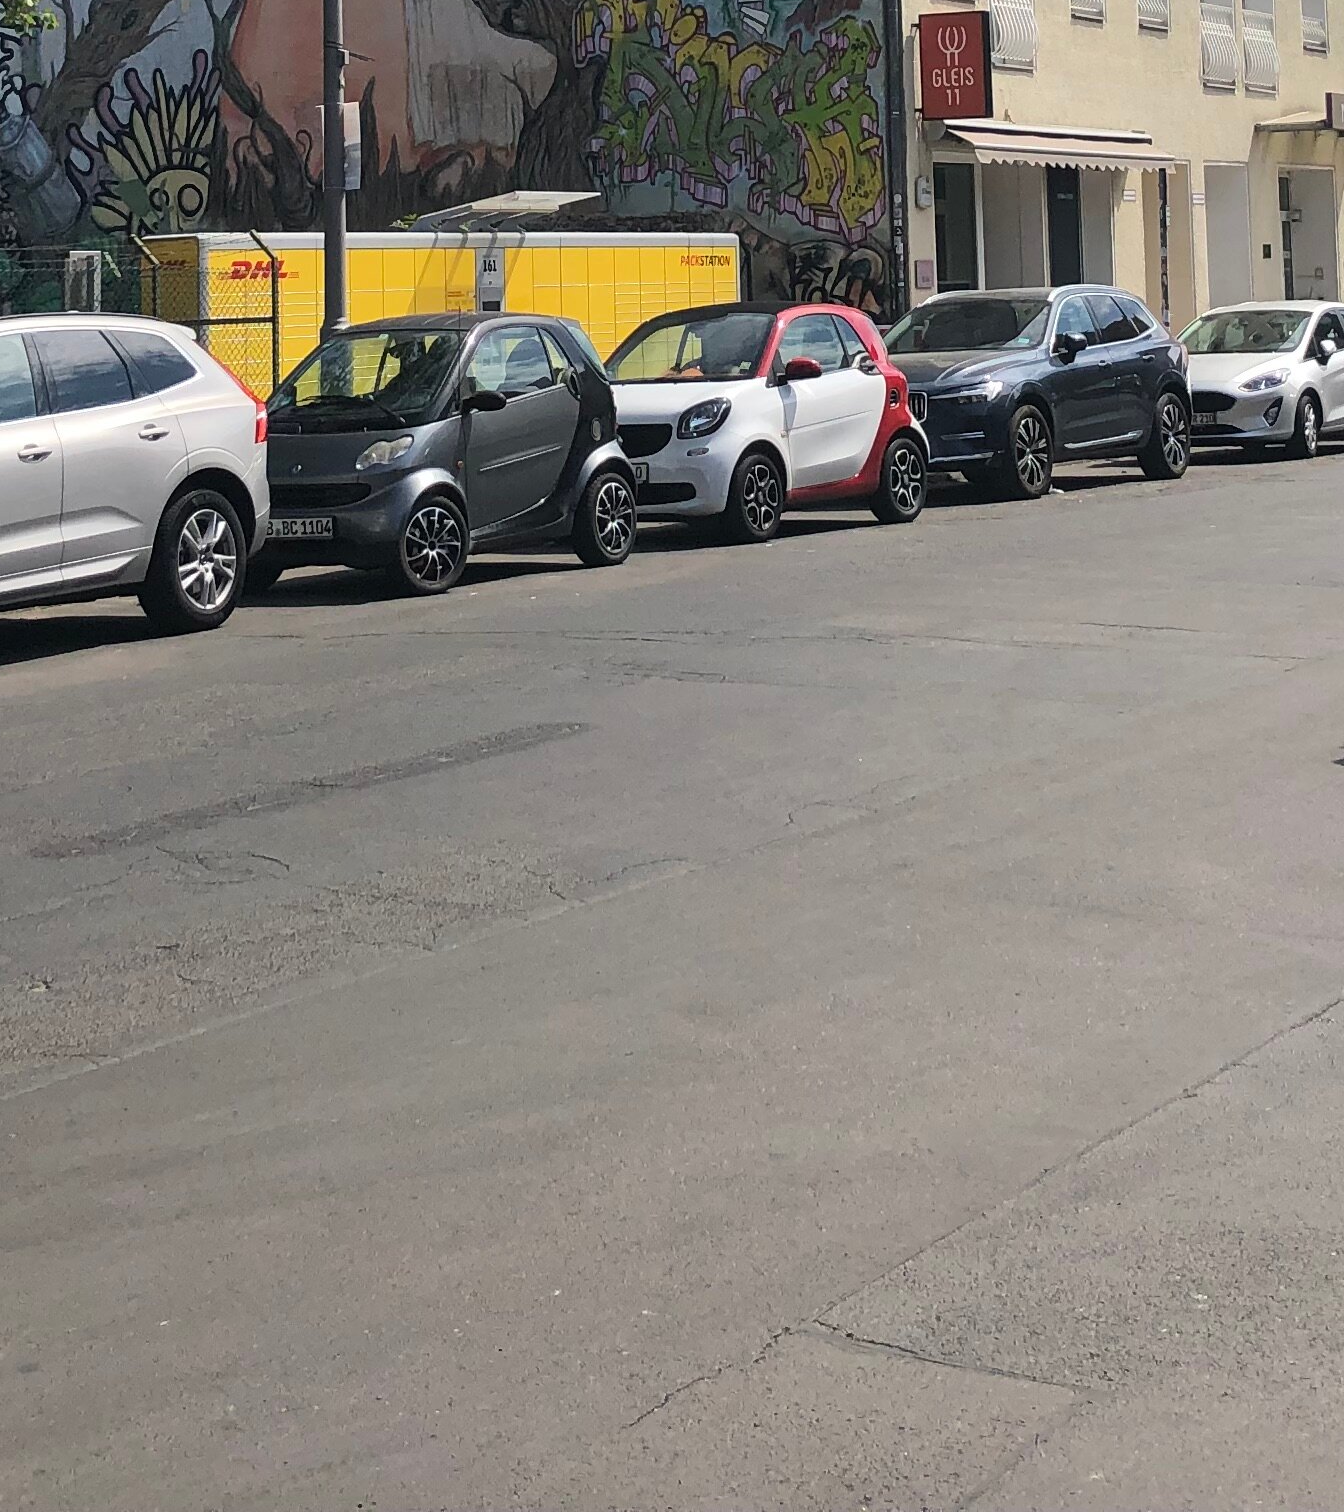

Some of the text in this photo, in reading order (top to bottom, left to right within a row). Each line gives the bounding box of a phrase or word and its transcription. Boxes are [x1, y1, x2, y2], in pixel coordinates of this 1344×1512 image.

[932, 67, 975, 87] GLEIS
[946, 88, 961, 106] 11
[482, 259, 497, 272] 161
[680, 255, 731, 267] PACKSTATION
[229, 260, 288, 280] DHL
[300, 520, 332, 535] 1104
